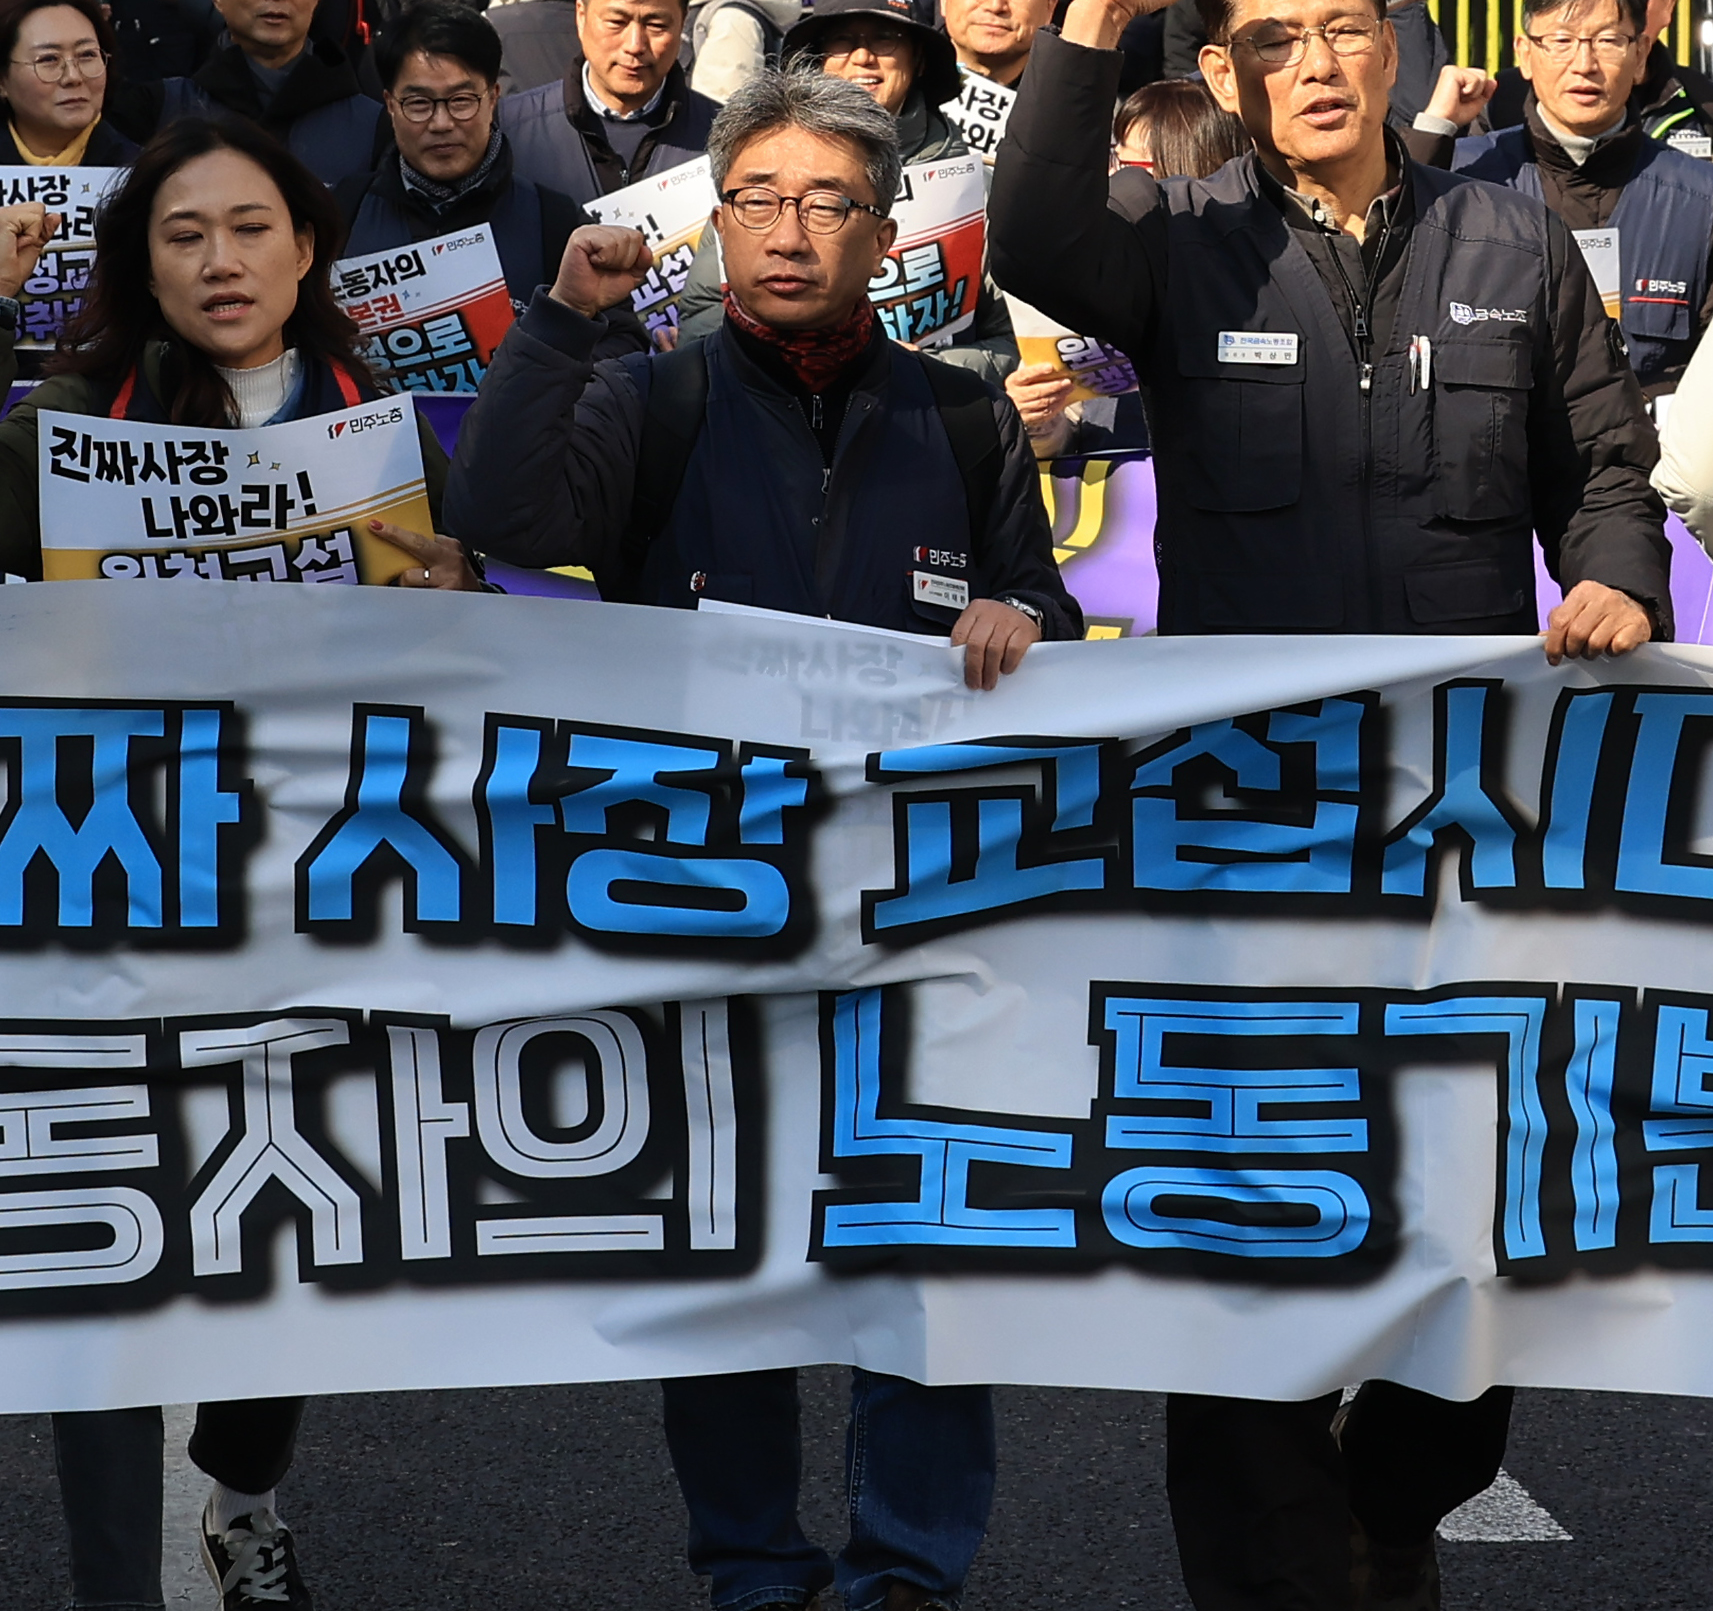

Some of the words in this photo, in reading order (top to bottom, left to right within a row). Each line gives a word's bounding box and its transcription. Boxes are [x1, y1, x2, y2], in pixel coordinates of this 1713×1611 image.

[670, 165, 707, 187] 민주노총
[937, 163, 977, 180] 민주노총
[447, 232, 487, 248] 민주노총
[1648, 279, 1687, 294] 민주노총
[1475, 308, 1527, 323] 금속노조
[349, 405, 405, 438] 민주노총
[49, 426, 231, 488] 진짜사장
[144, 469, 317, 541] 나와라!
[930, 549, 968, 568] 민주노총
[297, 704, 809, 942] 사장
